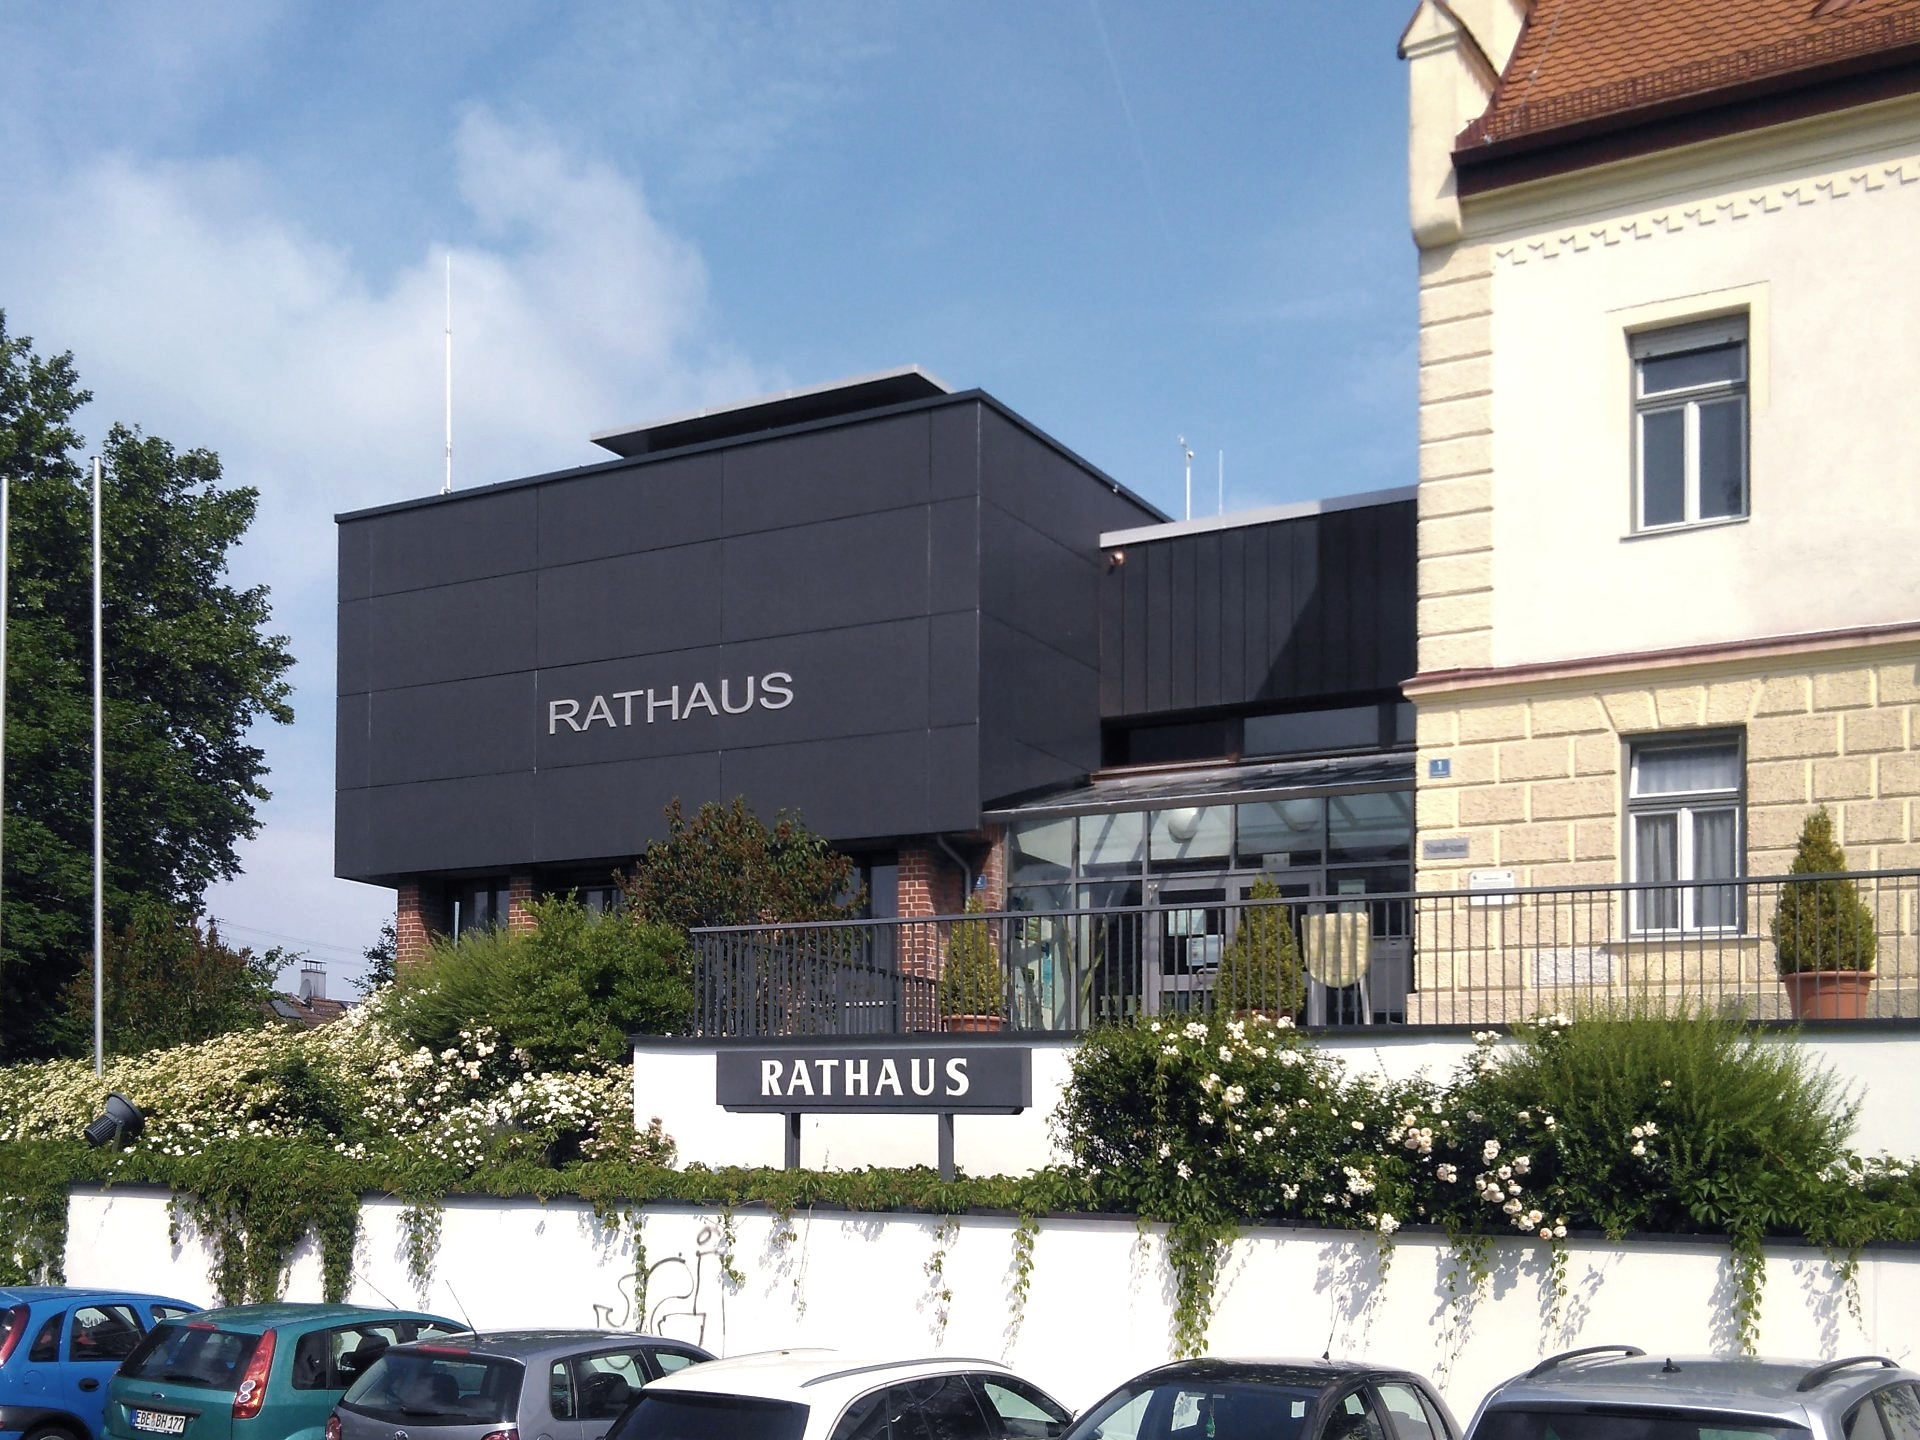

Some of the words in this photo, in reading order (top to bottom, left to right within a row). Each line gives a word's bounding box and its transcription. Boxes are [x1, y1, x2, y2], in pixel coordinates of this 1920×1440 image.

[549, 671, 794, 735] RATHAUS
[761, 1058, 970, 1096] RATHAUS
[135, 1411, 151, 1426] EBE
[168, 1416, 184, 1430] 177
